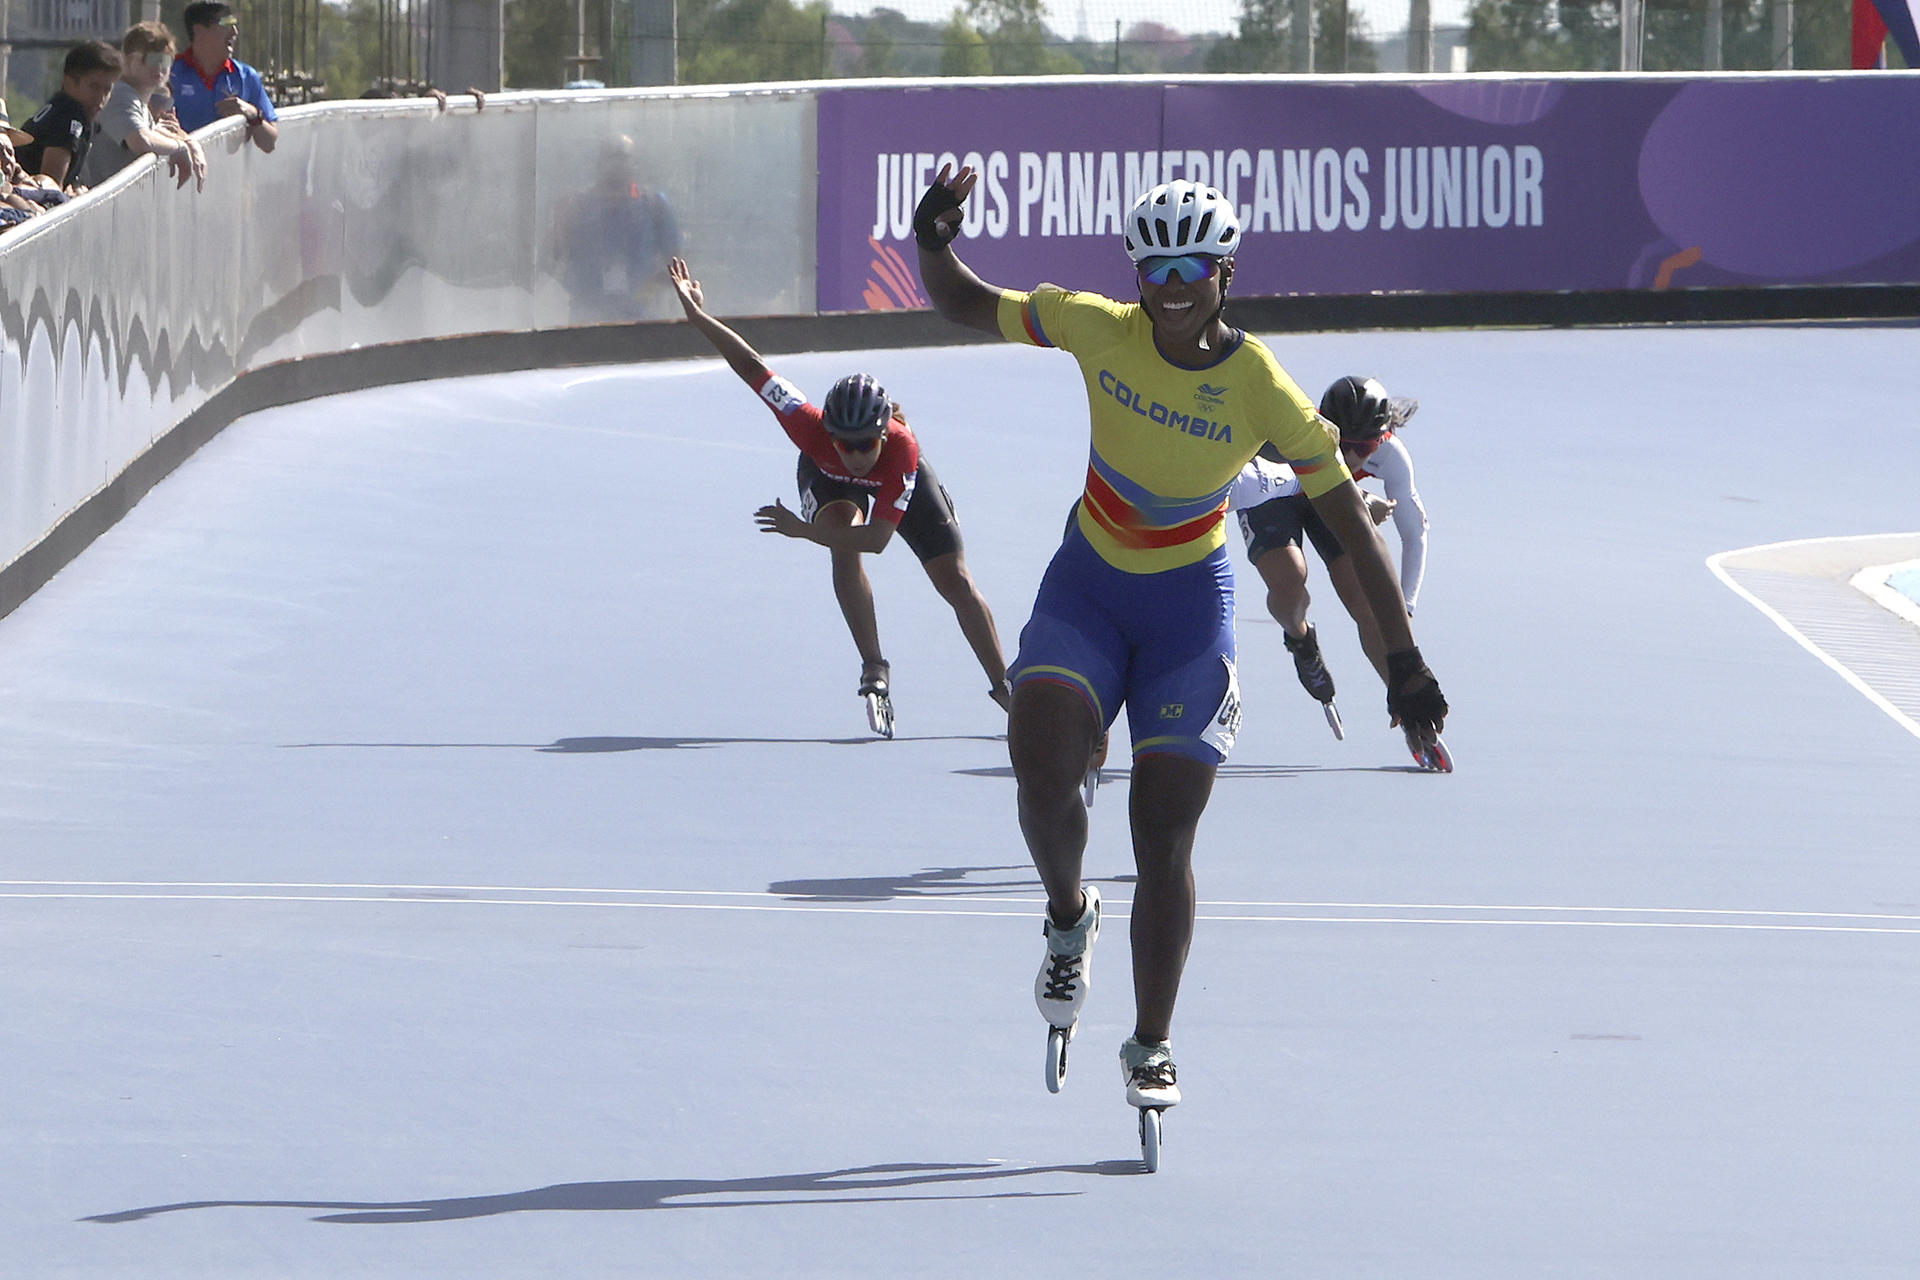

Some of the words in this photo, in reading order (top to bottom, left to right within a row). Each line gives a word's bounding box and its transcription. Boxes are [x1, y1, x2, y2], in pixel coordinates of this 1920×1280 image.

[1380, 145, 1543, 230] JUNIOR
[767, 383, 788, 403] 22
[1100, 369, 1231, 443] COLOMBIA
